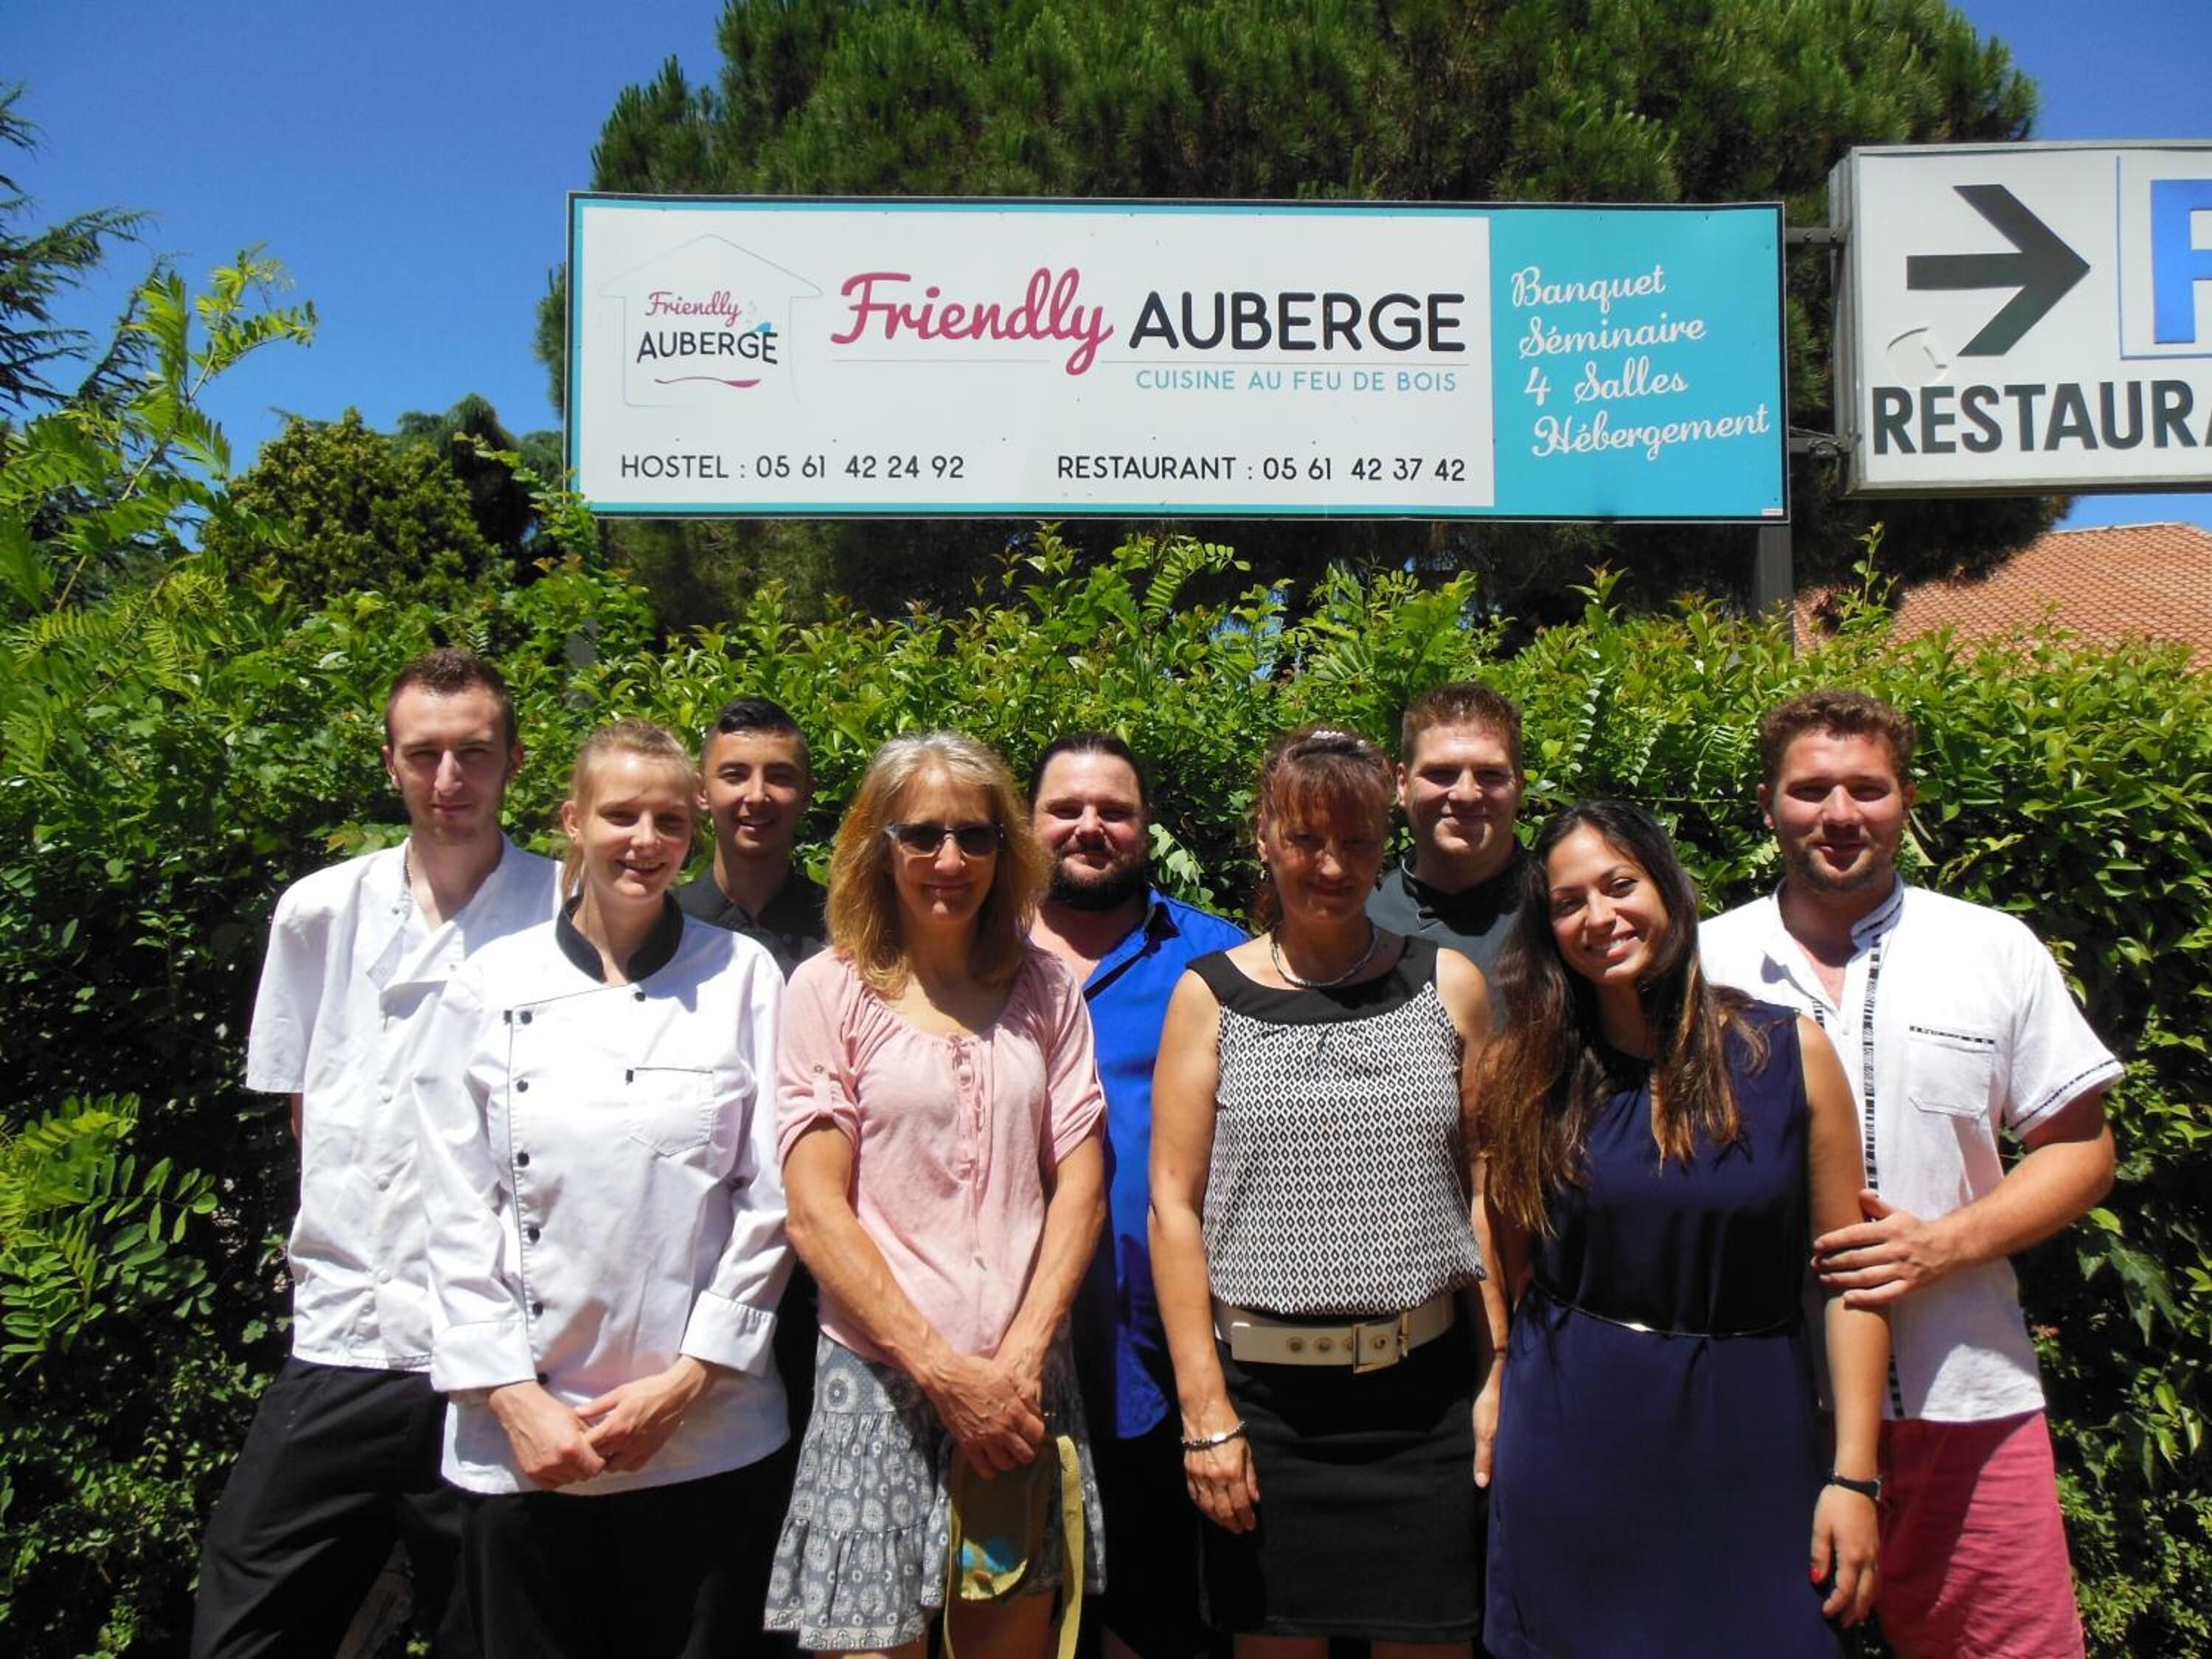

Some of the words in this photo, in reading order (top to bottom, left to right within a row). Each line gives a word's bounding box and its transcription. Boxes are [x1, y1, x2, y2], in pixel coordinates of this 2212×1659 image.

[644, 291, 742, 327] Friendly
[1510, 264, 1667, 314] Banquet
[830, 267, 1113, 376] Friendly
[1129, 291, 1467, 352] AUBERGE
[1519, 313, 1708, 359] Séminaire
[636, 328, 779, 365] AUBERGE
[1136, 369, 1235, 390] CUISINE
[1248, 370, 1282, 391] AU
[1293, 371, 1343, 392] FEU
[1353, 372, 1385, 392] DE
[1397, 371, 1457, 393] BOIS
[1523, 366, 1551, 406] 4
[1574, 355, 1689, 404] Salles
[1531, 403, 1771, 461] Hébergement
[1871, 380, 2212, 455] RESTAUR
[620, 455, 729, 479] HOSTEL
[755, 455, 791, 479] 05
[801, 455, 827, 479] 61
[844, 455, 877, 479] 42
[887, 455, 921, 479] 24
[931, 455, 964, 479] 92
[1058, 455, 1237, 480] RESTAURANT
[1262, 457, 1298, 481] 05
[1307, 457, 1332, 481] 61
[1350, 457, 1383, 481] 42
[1392, 457, 1424, 481] 37
[1433, 458, 1466, 481] 42
